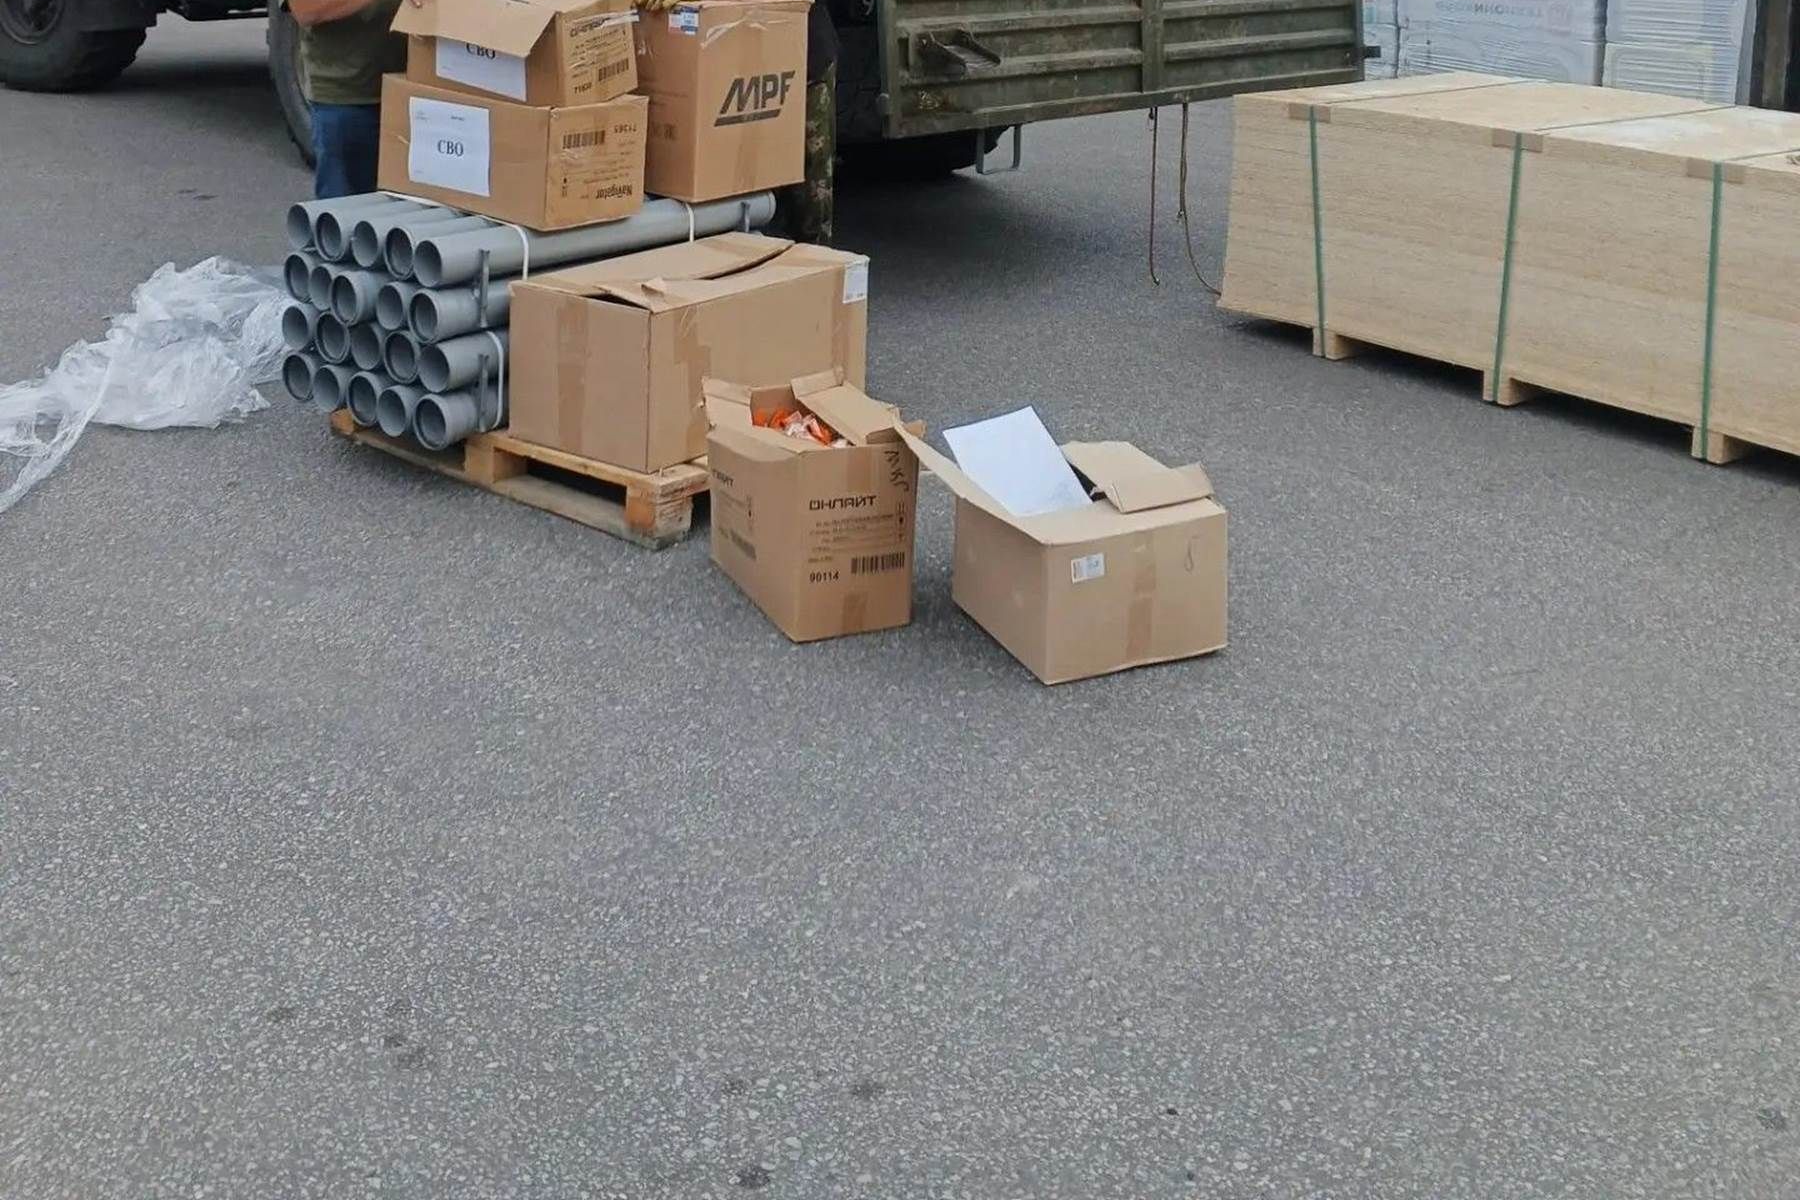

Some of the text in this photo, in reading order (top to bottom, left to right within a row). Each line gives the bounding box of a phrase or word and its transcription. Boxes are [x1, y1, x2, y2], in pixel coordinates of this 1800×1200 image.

[719, 70, 796, 115] MPF
[437, 139, 464, 157] СВО
[809, 570, 841, 583] 90114
